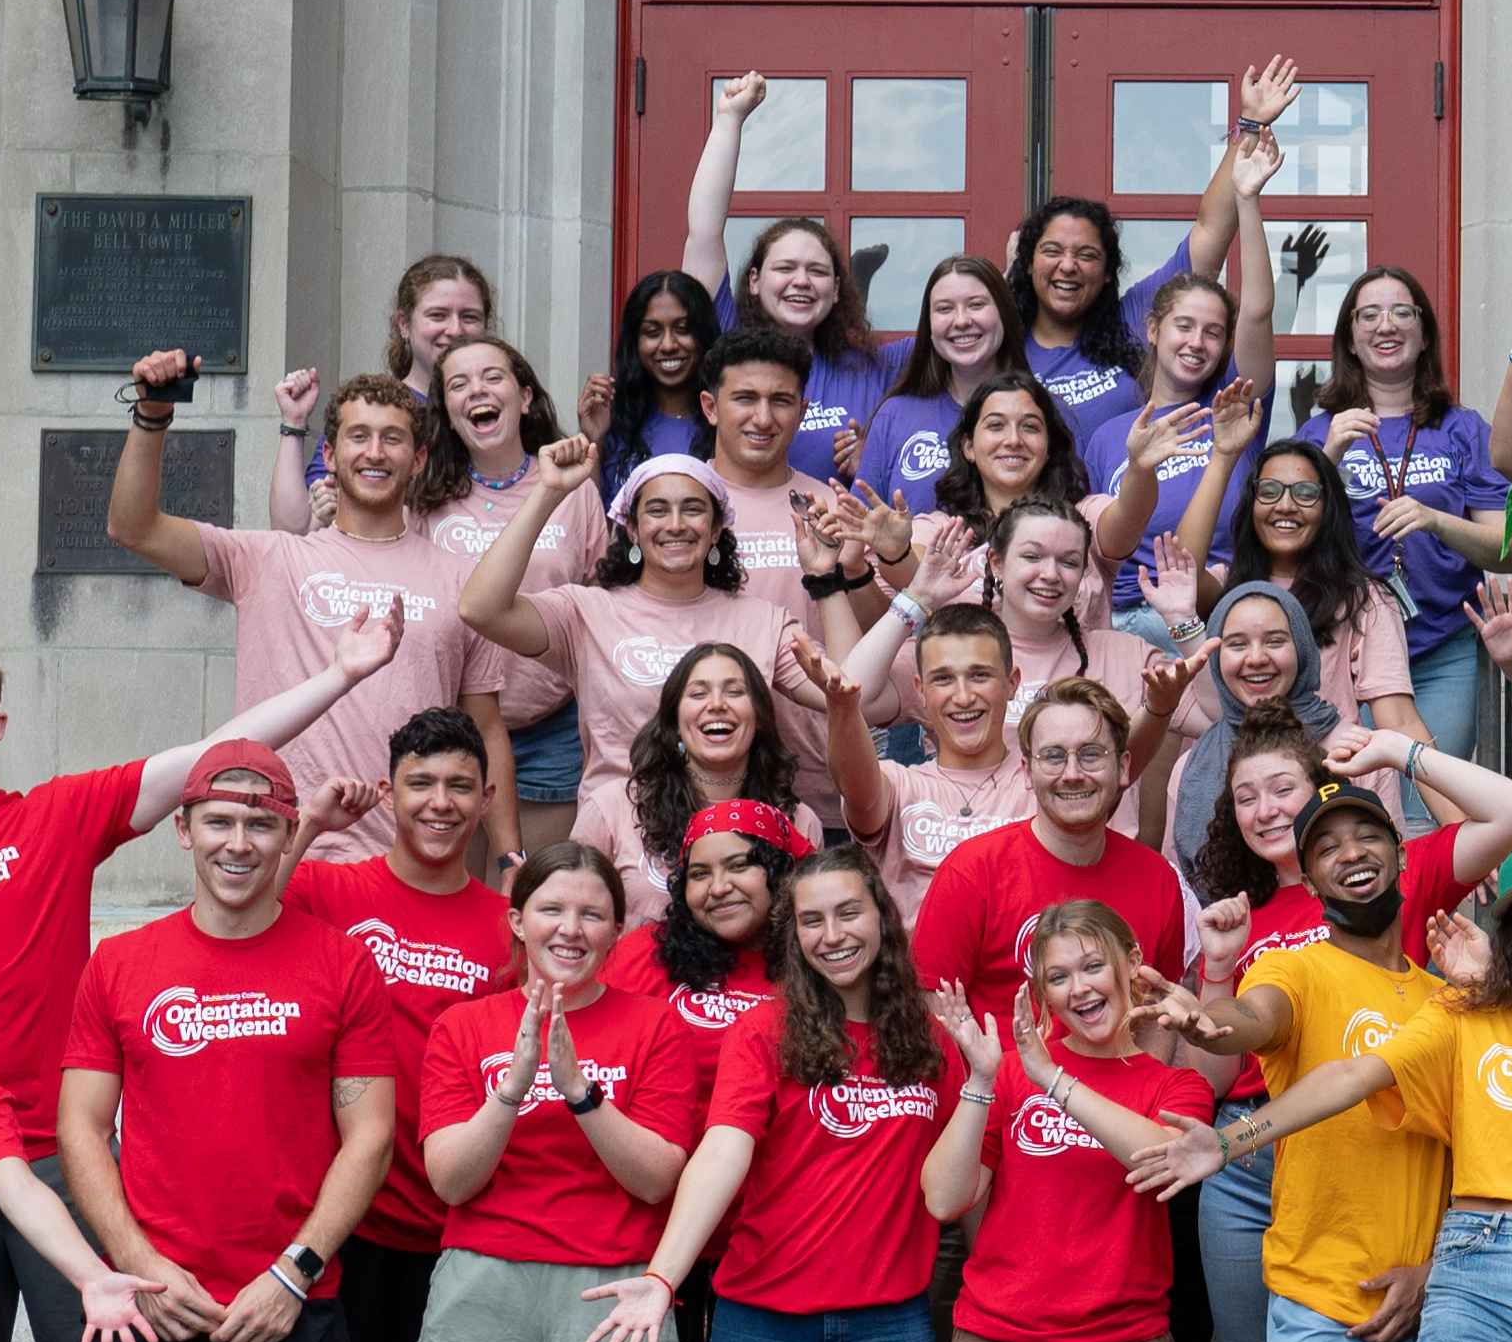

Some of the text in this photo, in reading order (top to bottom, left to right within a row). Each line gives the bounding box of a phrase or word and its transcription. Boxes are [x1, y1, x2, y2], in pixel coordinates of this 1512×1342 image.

[62, 211, 91, 228] THE
[97, 212, 146, 229] DAVID
[168, 214, 227, 230] MILLER
[94, 233, 193, 250] BELL TOWER
[79, 446, 116, 460] THIS
[73, 464, 87, 476] IS
[183, 465, 201, 477] TO
[75, 479, 104, 492] THE
[178, 480, 197, 492] OF
[163, 498, 221, 517] HAAS
[1318, 783, 1340, 803] P
[365, 935, 490, 983] Orientation
[374, 955, 475, 996] Weekend
[165, 998, 301, 1026] Orientation
[179, 1017, 287, 1042] Weekend
[847, 1095, 935, 1123] Weekend
